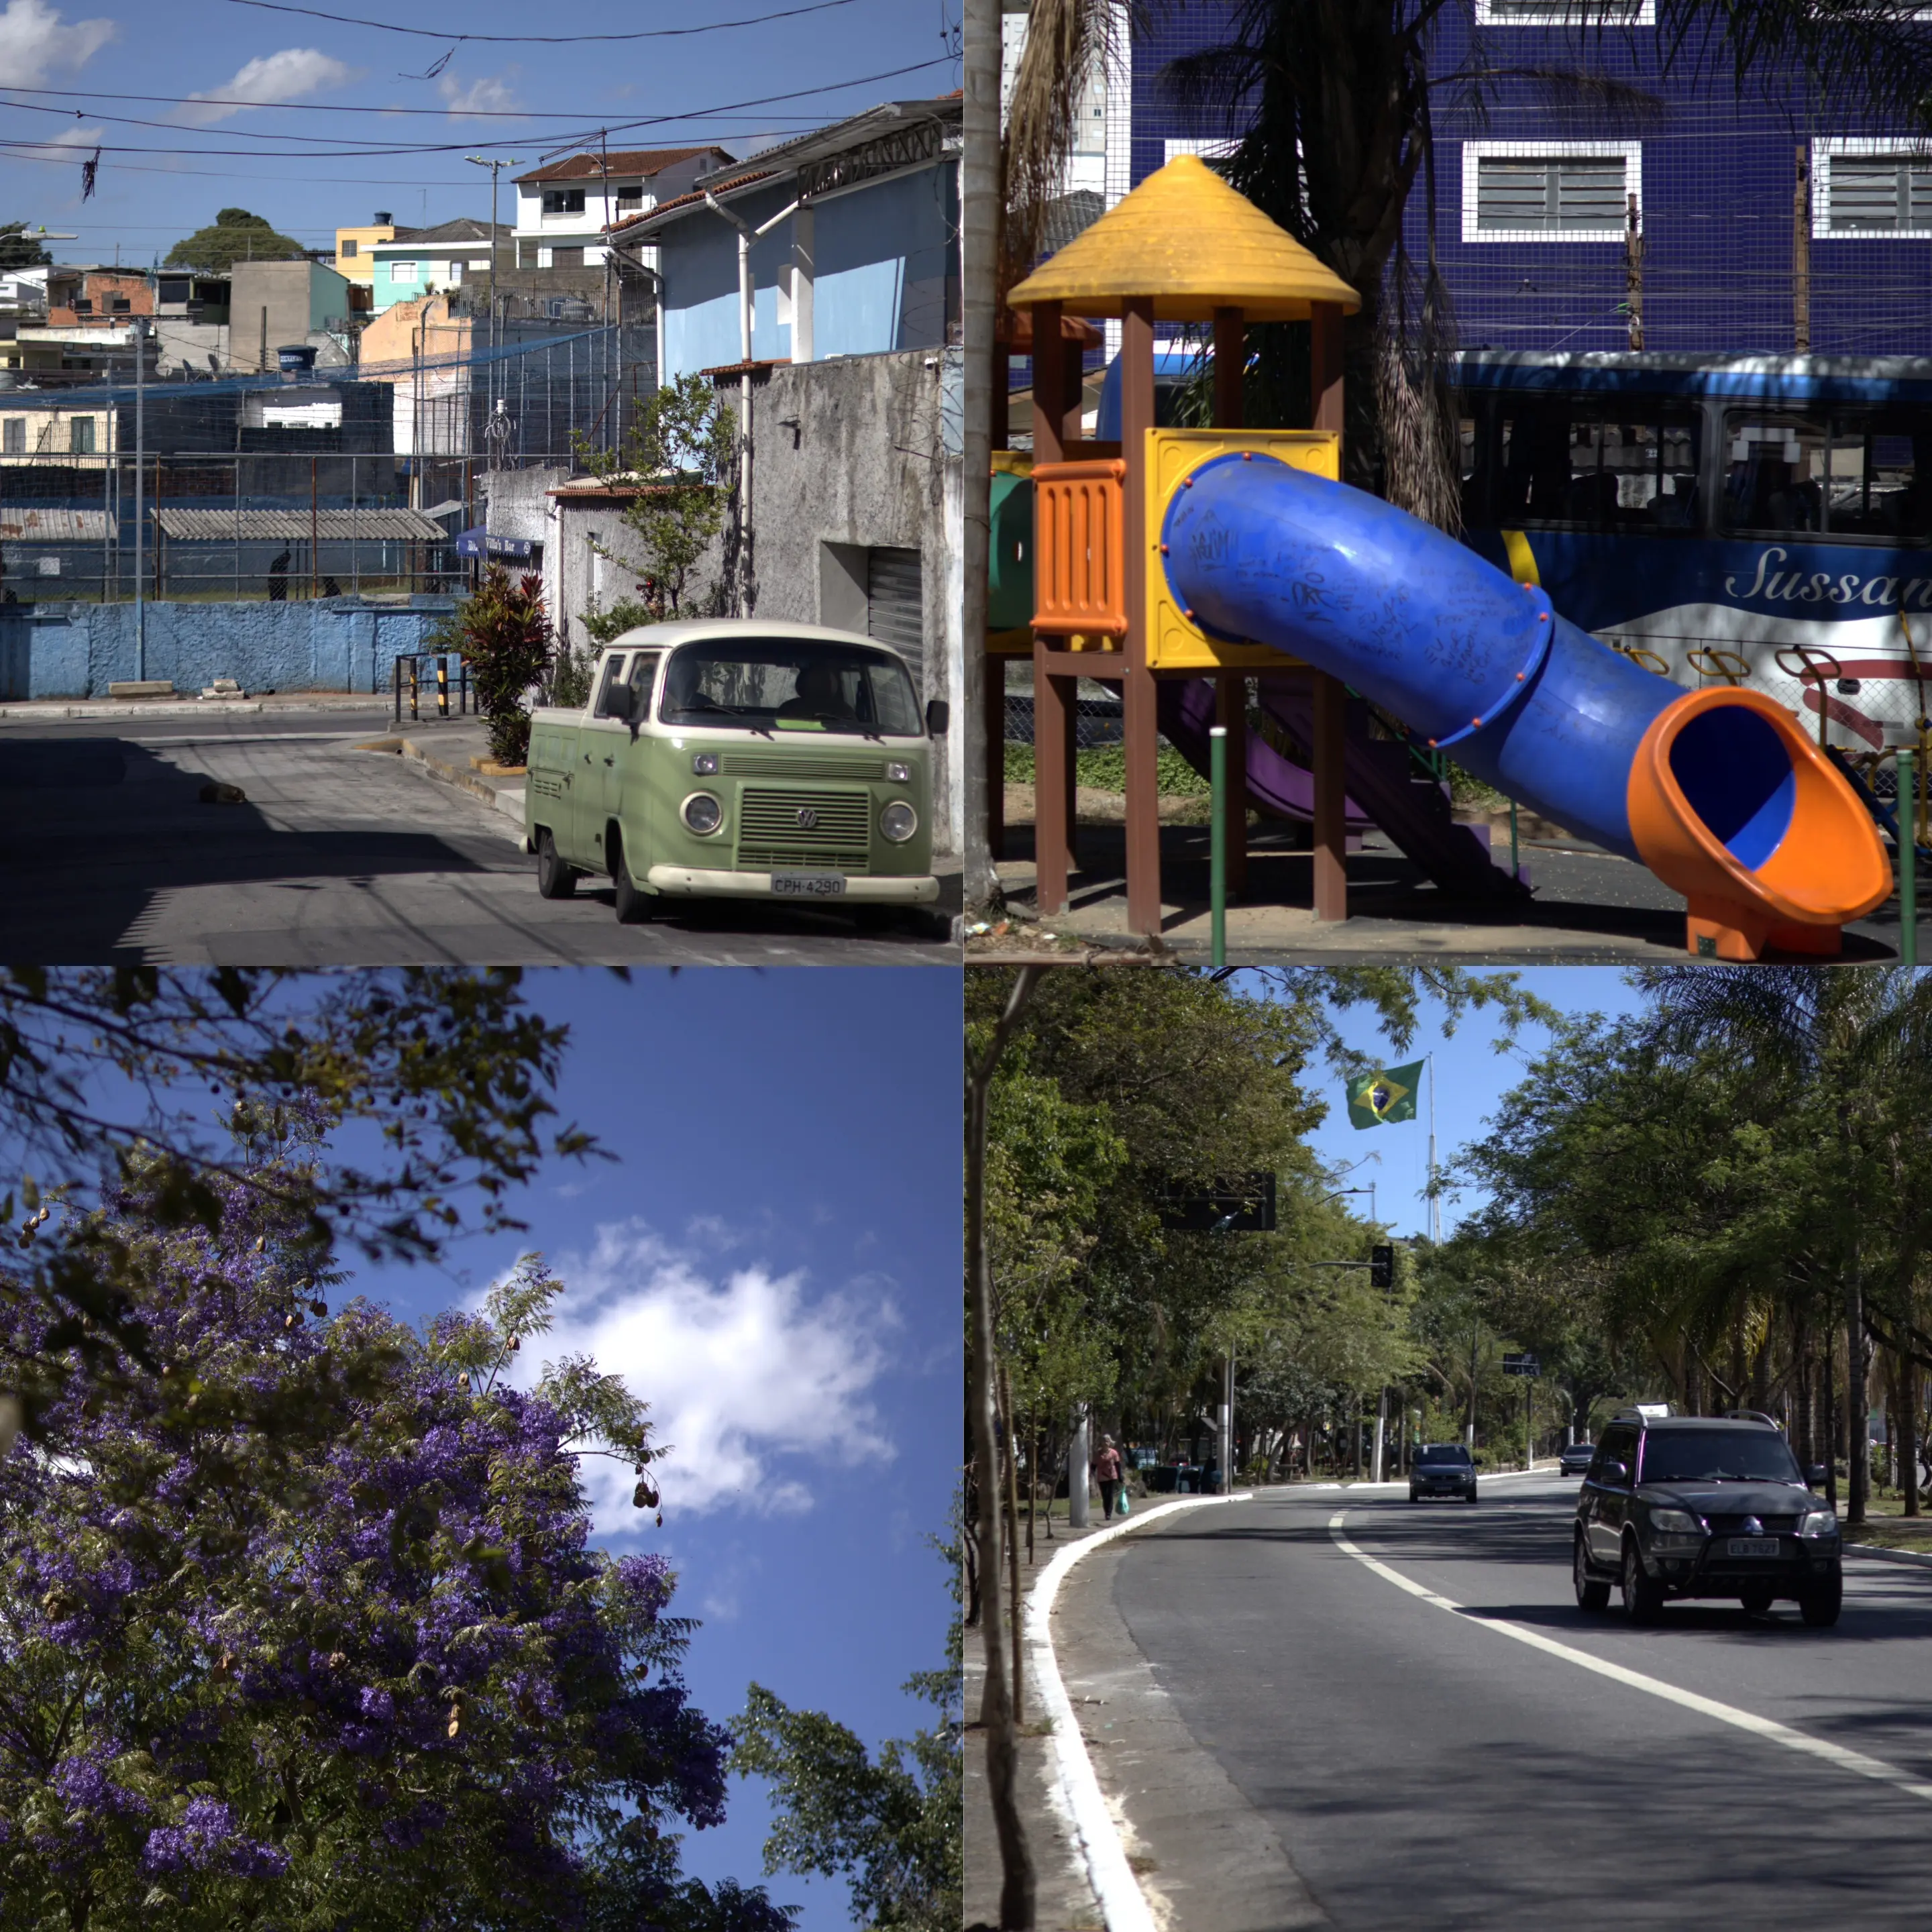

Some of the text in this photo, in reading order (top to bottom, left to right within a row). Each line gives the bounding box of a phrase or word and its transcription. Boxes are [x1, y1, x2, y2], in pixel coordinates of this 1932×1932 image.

[486, 537, 502, 551] Villa's
[504, 540, 515, 551] Bar
[1725, 547, 1932, 607] Sussan
